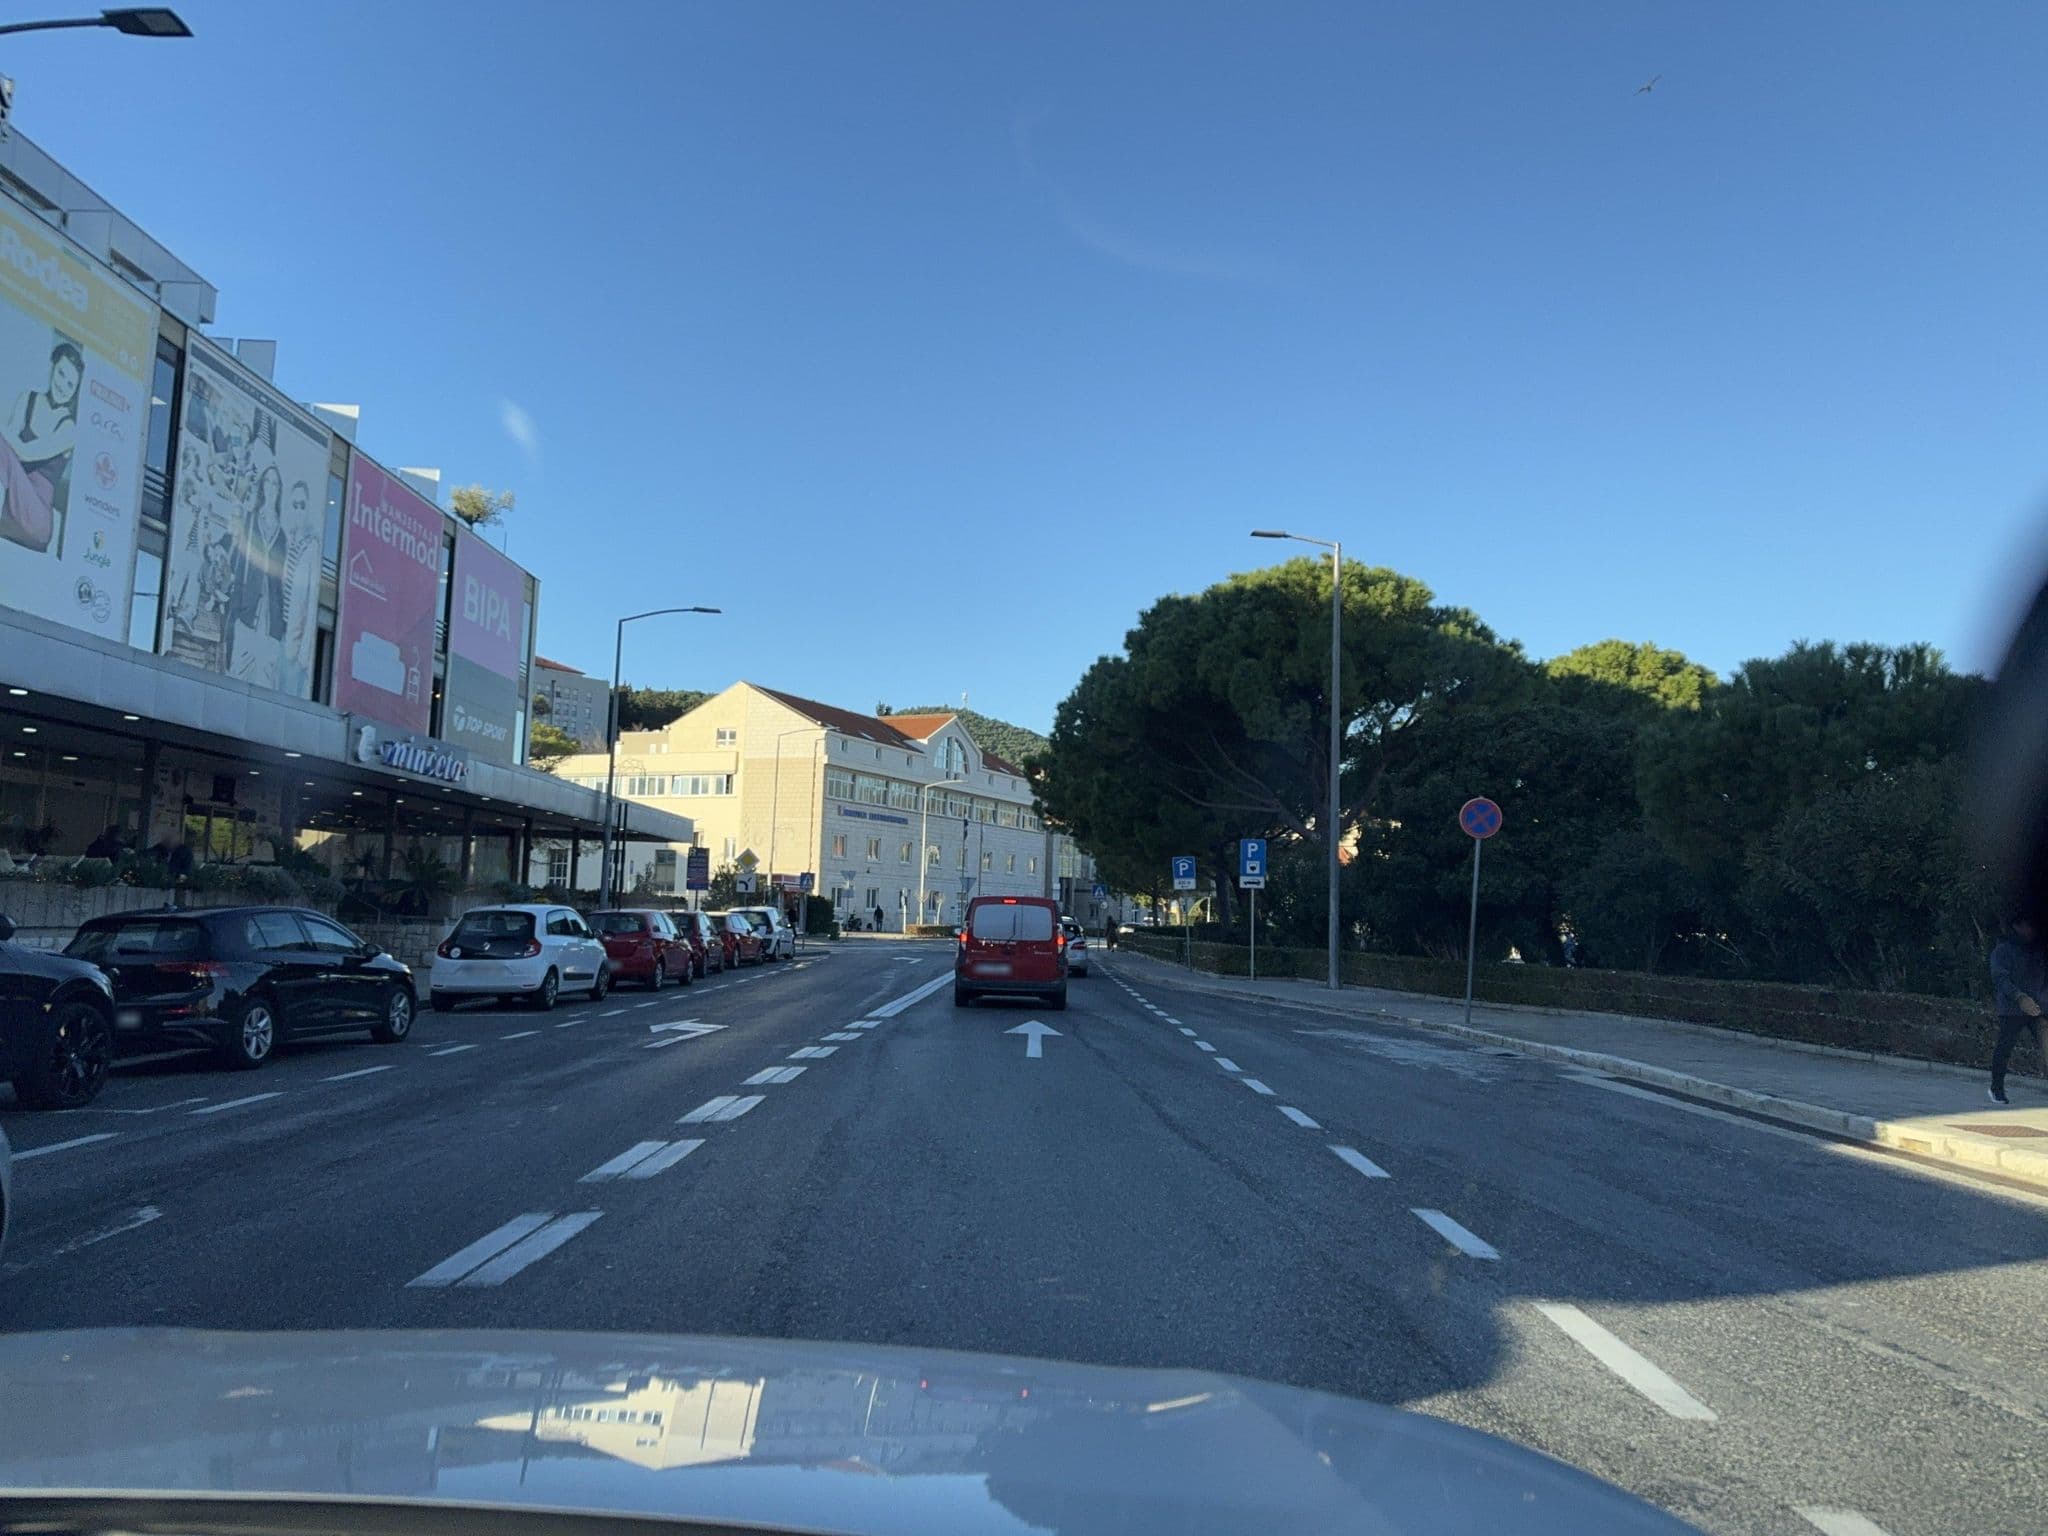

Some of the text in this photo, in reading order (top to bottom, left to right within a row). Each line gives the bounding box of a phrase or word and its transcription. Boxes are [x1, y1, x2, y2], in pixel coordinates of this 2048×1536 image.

[352, 482, 438, 572] Intermod
[464, 574, 511, 642] BIPA
[466, 715, 482, 734] TOP
[1247, 842, 1258, 858] P
[1180, 862, 1189, 876] P
